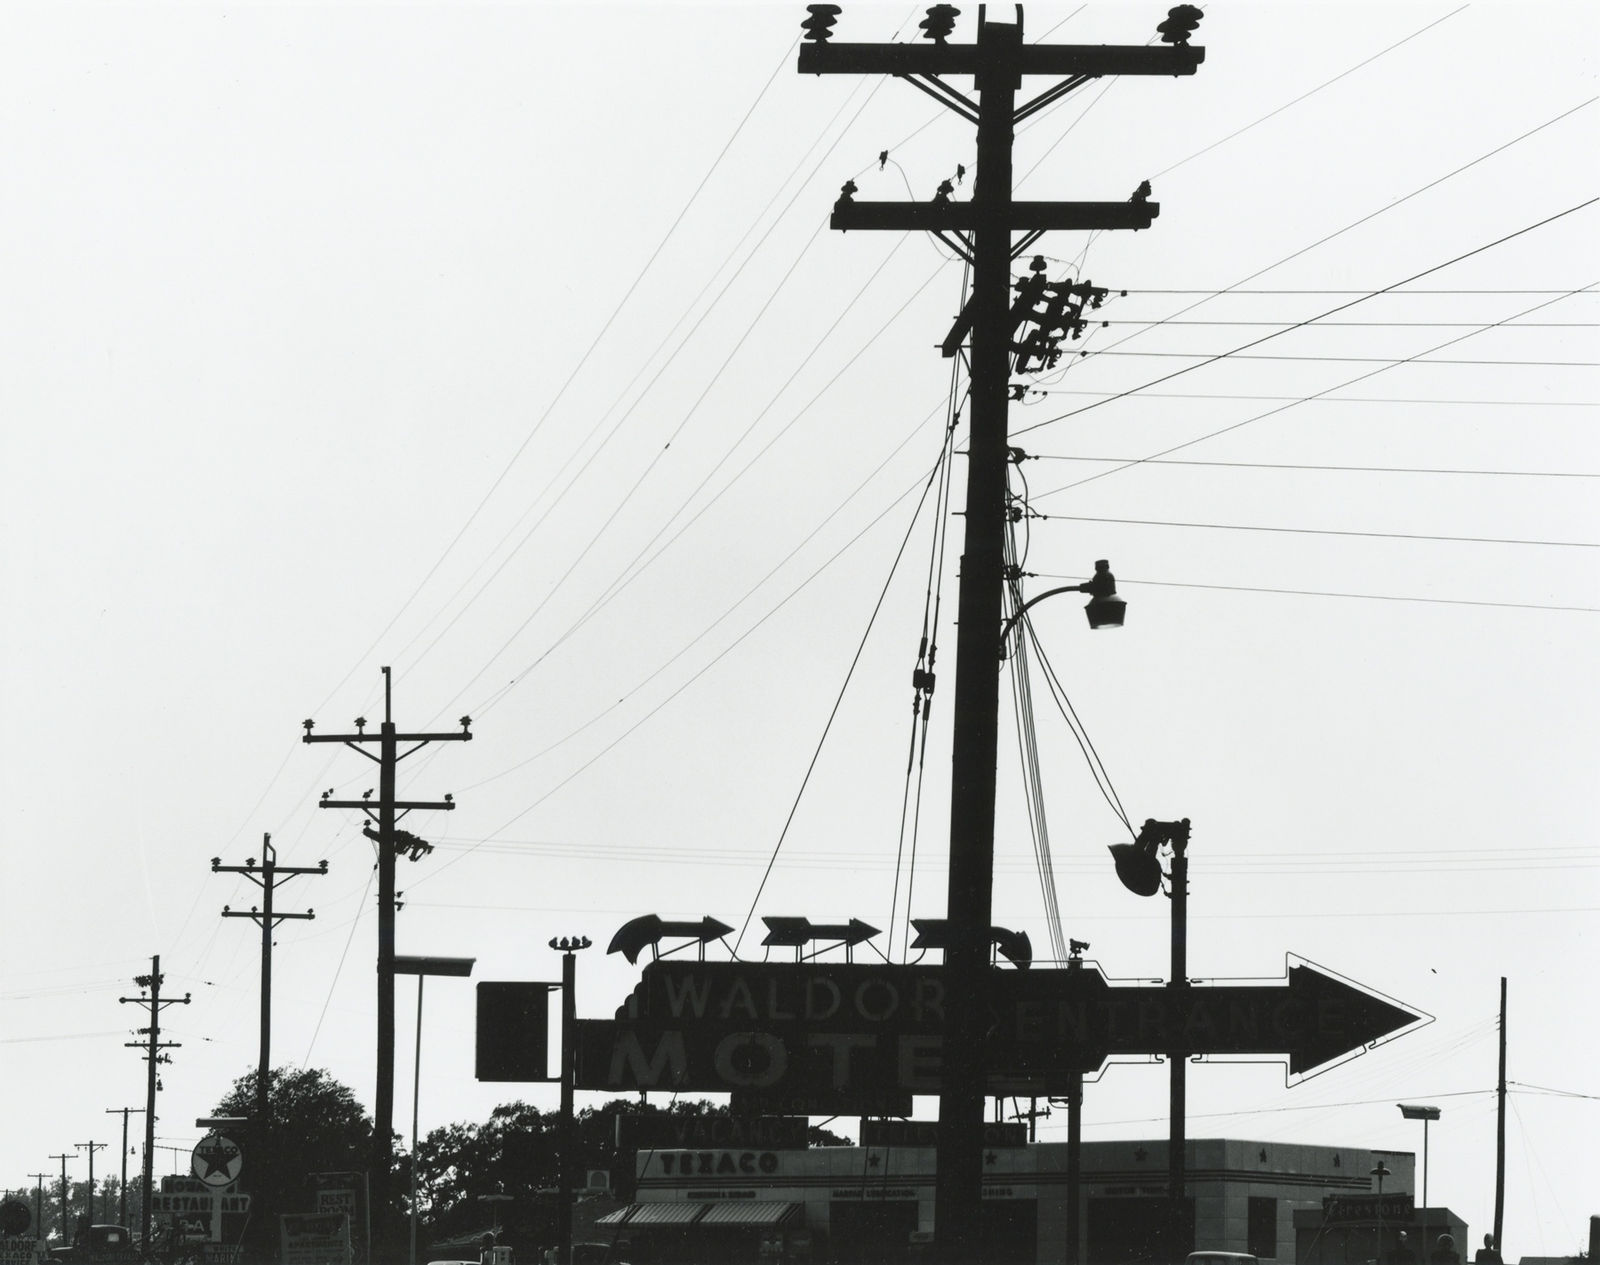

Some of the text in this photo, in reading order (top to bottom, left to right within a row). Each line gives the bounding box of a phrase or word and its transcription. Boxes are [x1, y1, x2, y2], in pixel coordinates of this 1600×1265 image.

[664, 973, 947, 1022] WALDOR
[1016, 997, 1346, 1043] ENTRANCE
[607, 1030, 946, 1089] MOTE
[675, 1119, 807, 1144] VACANCY
[659, 1152, 779, 1175] TEXACO
[152, 1196, 248, 1211] RESTAUANT
[321, 1193, 352, 1205] REST
